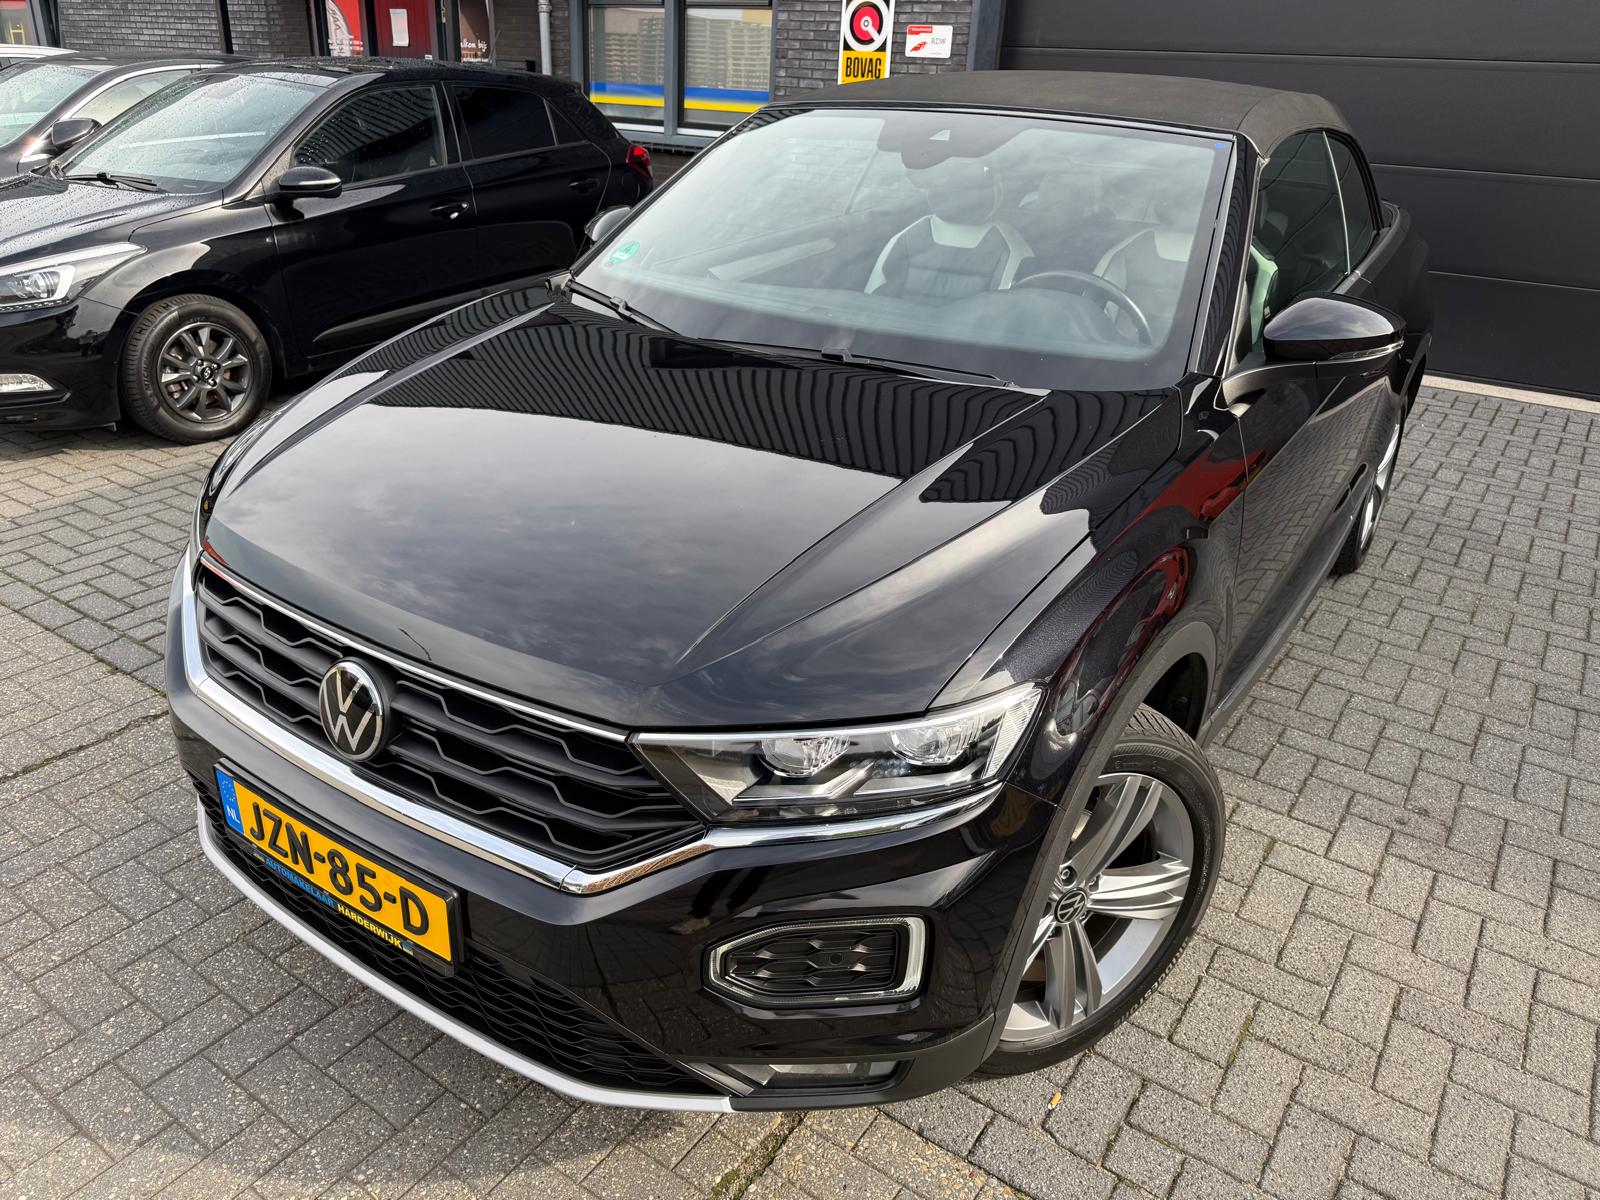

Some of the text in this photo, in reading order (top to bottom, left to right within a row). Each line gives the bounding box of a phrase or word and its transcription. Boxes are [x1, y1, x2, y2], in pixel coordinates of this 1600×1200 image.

[845, 57, 882, 79] BOVAG
[226, 805, 241, 825] NL
[249, 801, 429, 935] JZN-85-D
[265, 858, 403, 949] AUTOMAKELAAR HARDERWIJK
